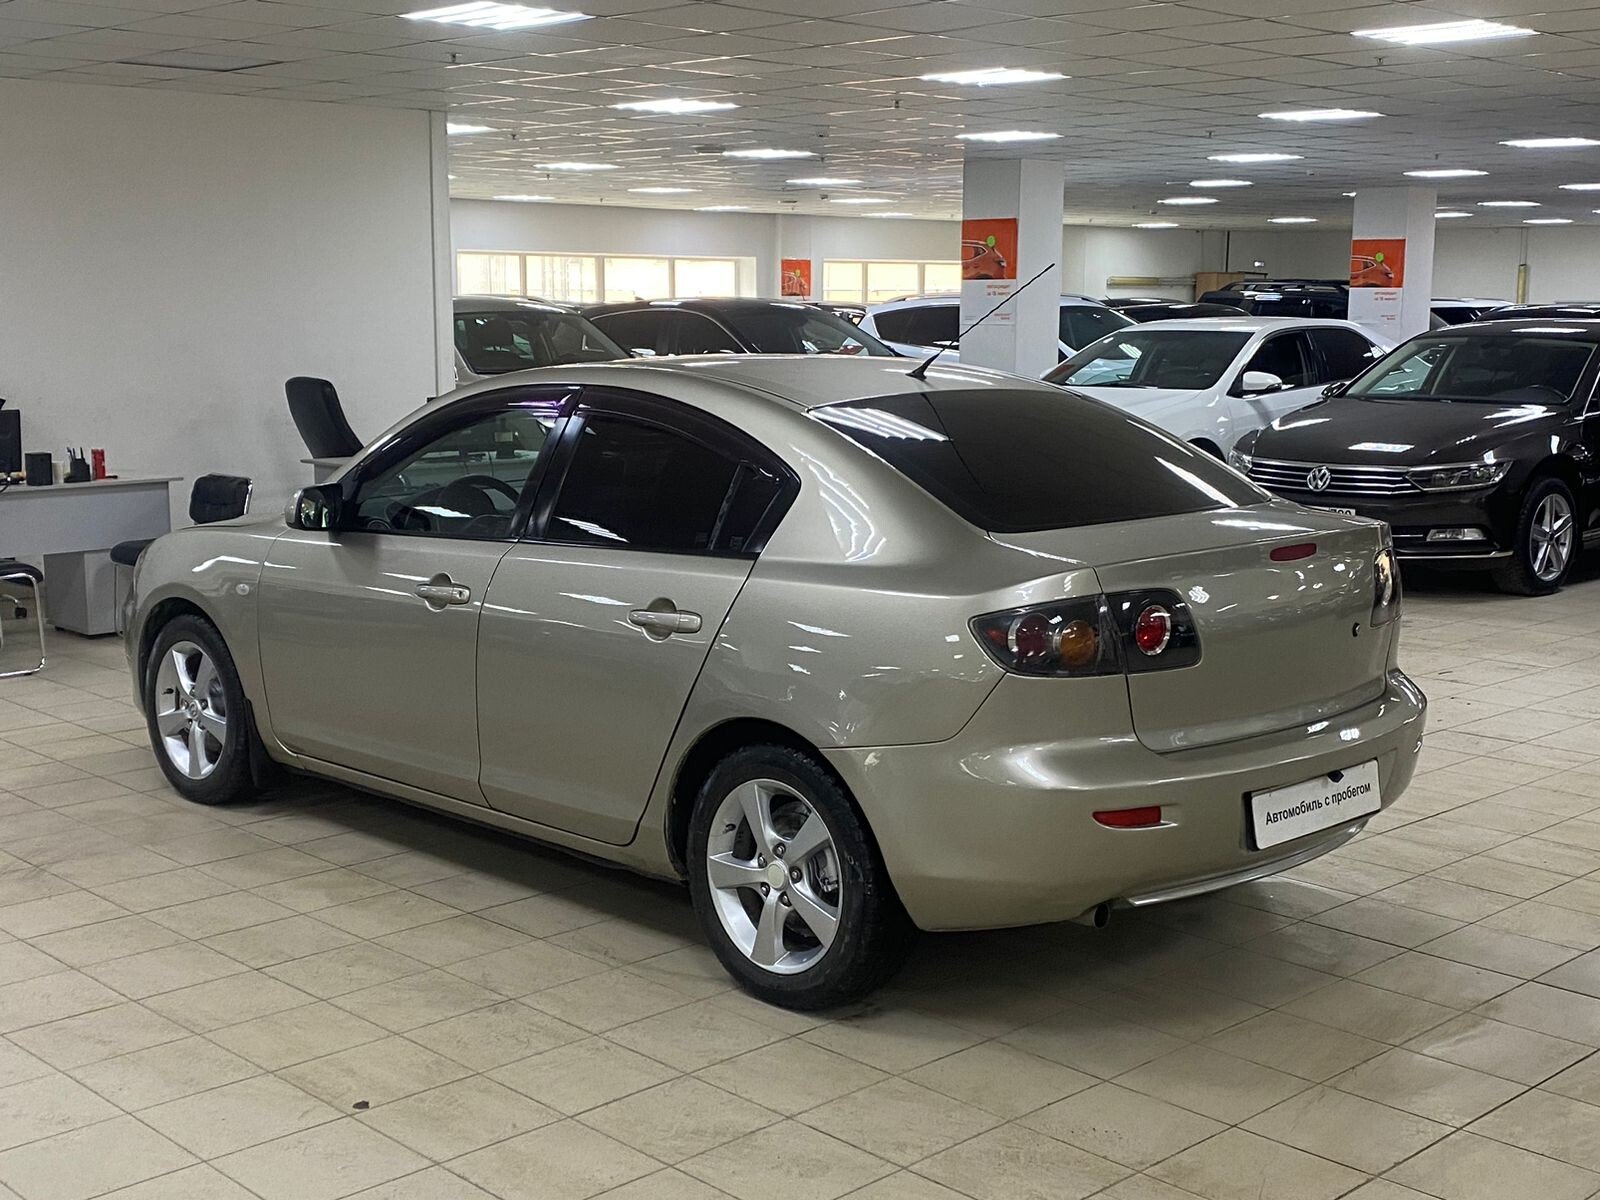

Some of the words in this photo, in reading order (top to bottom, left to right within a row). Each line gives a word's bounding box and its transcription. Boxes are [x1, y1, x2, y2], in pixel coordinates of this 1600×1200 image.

[1265, 798, 1323, 825] Автомобиль
[1324, 797, 1330, 807] с
[1331, 782, 1371, 806] пробегом
